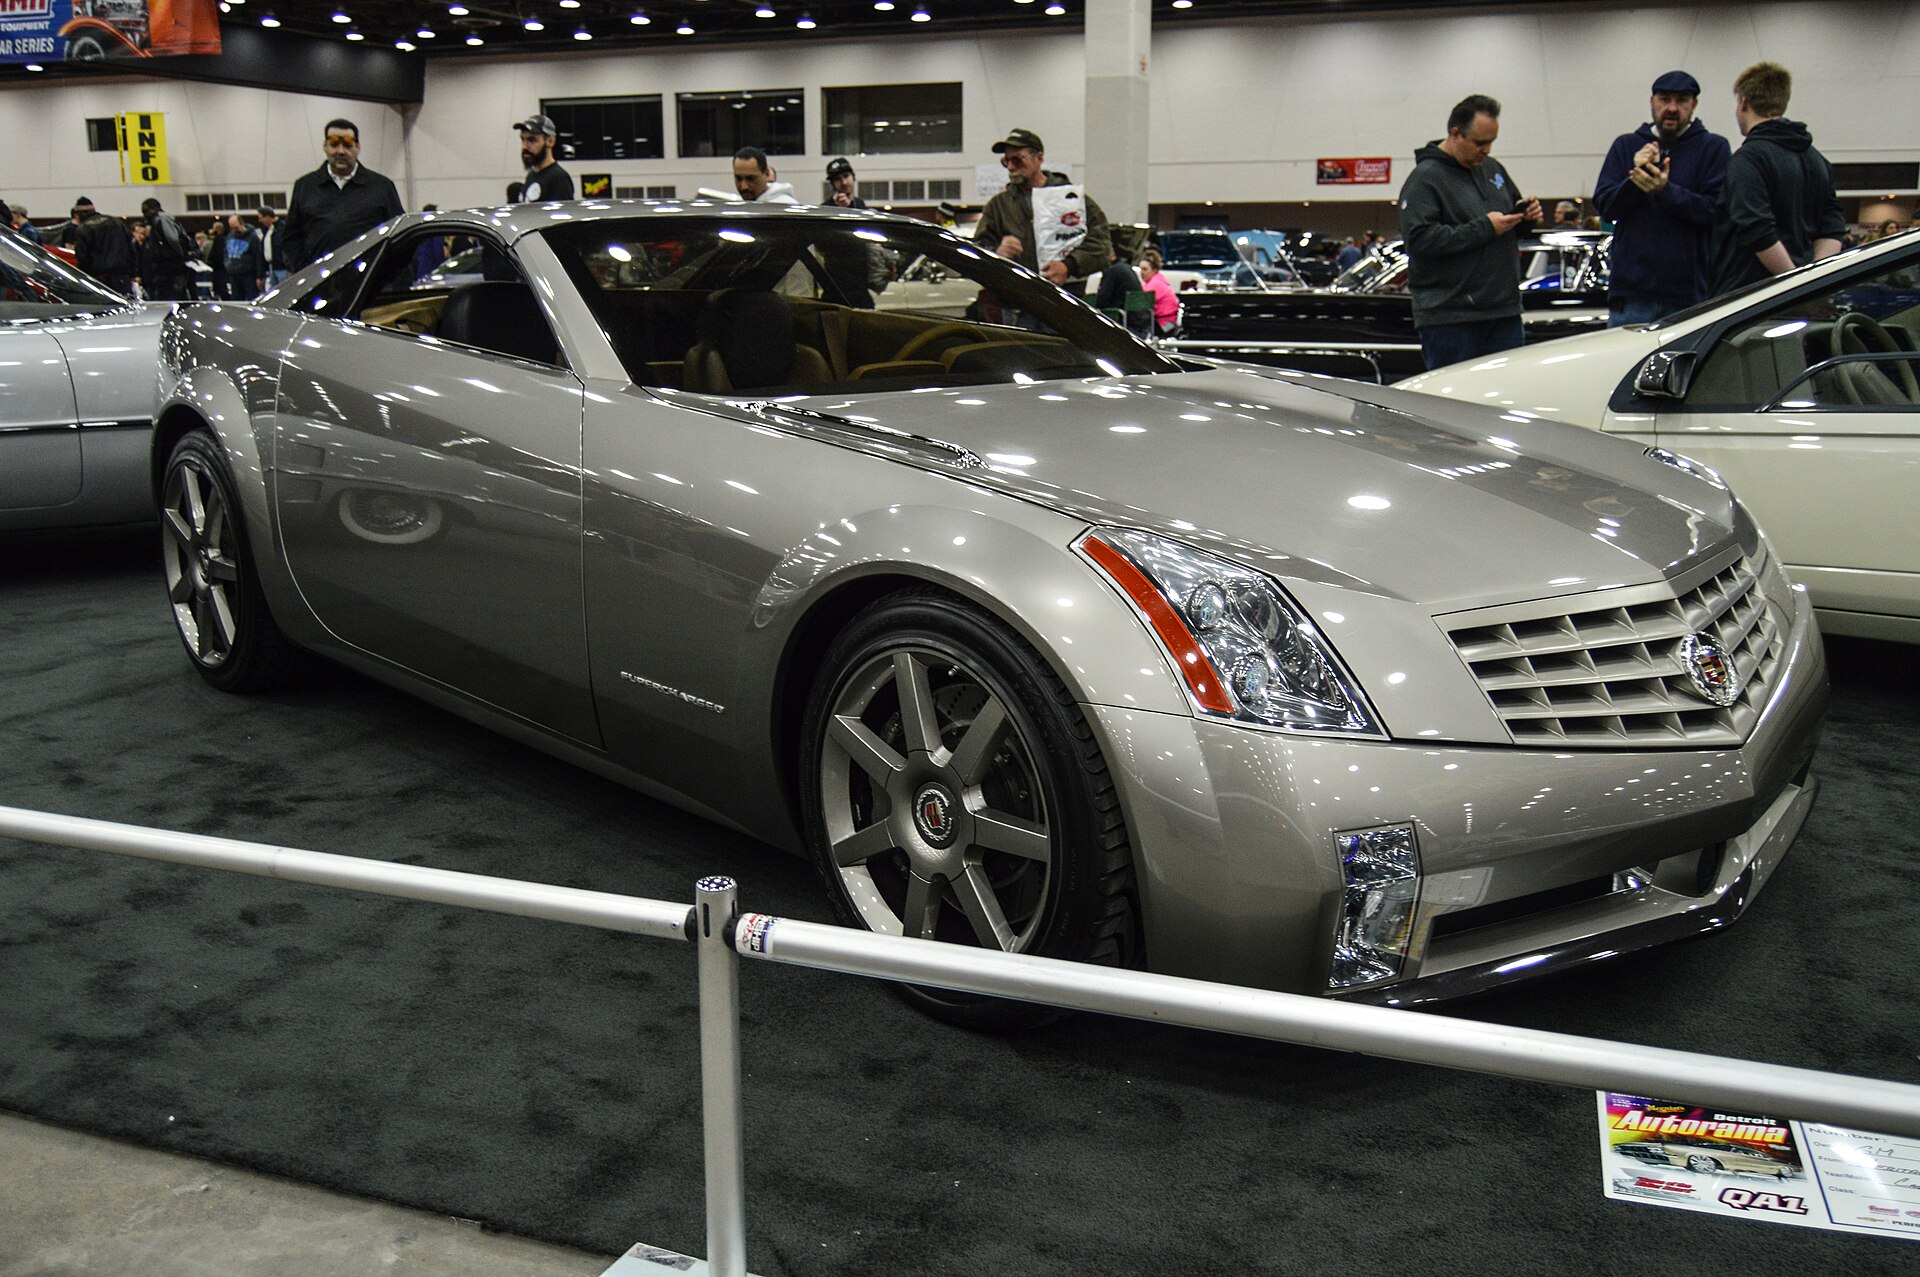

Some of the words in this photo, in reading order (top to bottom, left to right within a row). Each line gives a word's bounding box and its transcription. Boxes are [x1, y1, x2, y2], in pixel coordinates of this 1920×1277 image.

[15, 37, 55, 54] SERIES
[138, 114, 159, 181] INFO
[620, 671, 725, 713] SUPERCHARGED
[1612, 1110, 1788, 1144] Autorama
[1713, 1113, 1777, 1125] Detroit
[1718, 1187, 1808, 1215] QA1
